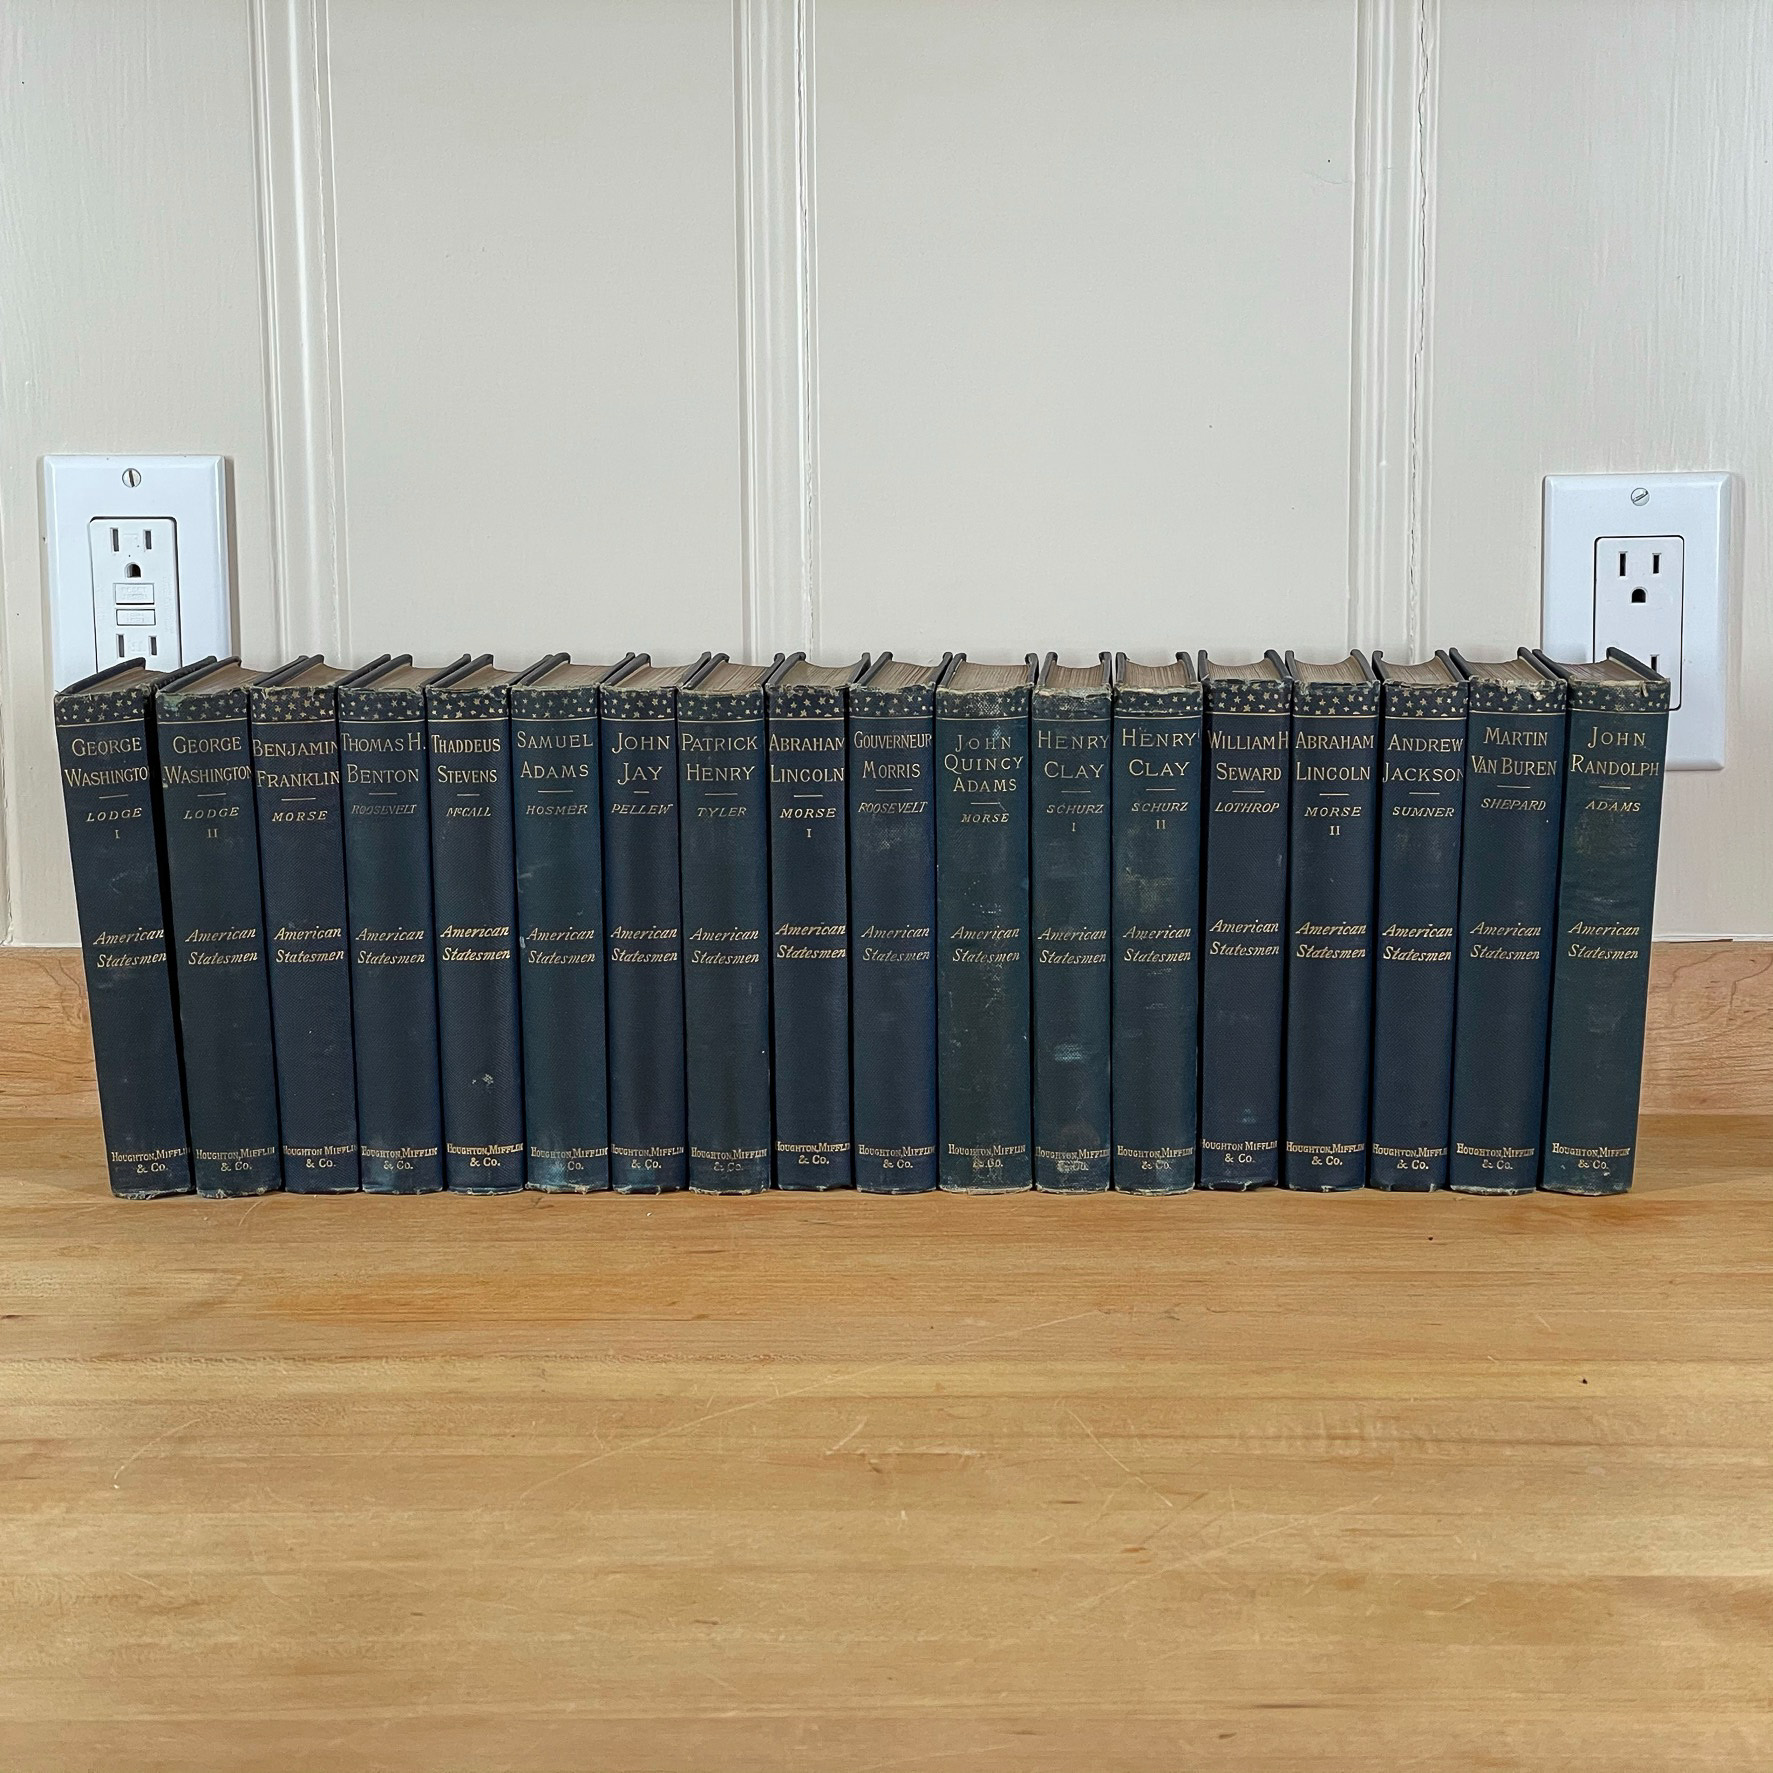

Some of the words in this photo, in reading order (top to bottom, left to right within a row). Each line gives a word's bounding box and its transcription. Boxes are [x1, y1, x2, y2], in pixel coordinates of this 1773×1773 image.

[340, 732, 404, 752] THOMAS
[408, 732, 427, 751] H.
[431, 734, 501, 753] THADDEUS
[517, 731, 594, 749] SAMUEL
[611, 732, 670, 754] JOHN
[681, 733, 758, 751] PATRICK
[853, 730, 932, 749] GOUVERNEUR
[955, 734, 1011, 752] JOHN
[1037, 730, 1110, 750] HENRY
[1121, 728, 1196, 747] HENRY
[1207, 729, 1275, 751] WILLIAM
[1295, 731, 1375, 750] ABRAHAM
[1387, 734, 1463, 752] ANDREW
[1483, 727, 1548, 746] MARTIN
[1587, 726, 1646, 749] JOHN
[71, 737, 142, 757] GEORGE
[173, 736, 242, 754] GEORGE
[520, 761, 589, 778] ADAMS
[862, 760, 921, 779] MORRIS
[944, 753, 1024, 775] QUINCY
[1044, 761, 1105, 779] CLAY
[1128, 759, 1190, 777] CLAY
[1216, 762, 1282, 781] SEWARD
[1296, 761, 1371, 781] LINCOLN
[1470, 755, 1497, 775] VAN
[1502, 757, 1557, 776] BUREN
[1570, 754, 1660, 776] RANDOLPH
[64, 766, 149, 788] WASHINGTO
[257, 770, 340, 788] FRANKLIN
[347, 764, 419, 784] BENTON
[438, 765, 498, 783] STEVENS
[617, 762, 663, 786] JAY
[686, 763, 755, 781] HENRY
[770, 764, 845, 783] LINCOLN
[953, 777, 1017, 792] ADAMS
[351, 804, 417, 815] ROOSEVELT
[526, 804, 588, 815] HOSMER
[611, 803, 674, 815] PELLEW
[858, 801, 928, 813] ROOSEVELT
[1046, 804, 1105, 814] SCHURZ
[1131, 802, 1189, 813] SCHURZ
[1215, 802, 1280, 813] LOTHROP
[1304, 806, 1362, 817] MORSE
[1392, 806, 1455, 817] SUMNER
[1480, 798, 1546, 811] SHEPARD
[1585, 801, 1641, 812] ADAMS
[87, 808, 142, 822] LODGE
[183, 807, 240, 820] LODGE
[272, 810, 328, 822] MORSE
[697, 807, 747, 818] TYLER
[779, 807, 837, 819] MORSE
[961, 813, 1010, 823] MORSE
[1071, 822, 1076, 832] I
[1155, 819, 1166, 829] II
[1329, 825, 1340, 836] II
[115, 829, 120, 839] I
[207, 829, 218, 838] II
[806, 828, 812, 838] I
[274, 925, 342, 941] American
[355, 926, 425, 941] American
[439, 924, 510, 938] American
[526, 926, 595, 941] American
[610, 925, 678, 939] American
[689, 926, 759, 941] American
[775, 922, 846, 936] American
[860, 924, 930, 938] American
[950, 925, 1020, 940] American
[1037, 926, 1107, 941] American
[1122, 924, 1192, 939] American
[1209, 919, 1279, 933] American
[1295, 921, 1367, 936] American
[1382, 923, 1454, 938] American
[1470, 921, 1541, 937] American
[1567, 921, 1640, 937] American
[93, 927, 165, 946] American
[185, 925, 256, 943] American
[275, 949, 345, 963] Statesmen
[442, 947, 511, 961] Statesmen
[611, 948, 678, 963] Statesmen
[776, 944, 846, 959] Statesmen
[862, 947, 930, 962] Statesmen
[952, 948, 1020, 963] Statesmen
[1123, 948, 1191, 963] Statesmen
[1209, 941, 1280, 956] Statesmen
[1296, 944, 1366, 959] Statesmen
[1382, 946, 1452, 961] Statesmen
[1470, 944, 1540, 960] Statesmen
[1567, 943, 1639, 960] Statesmen
[97, 952, 167, 968] Statesmen
[188, 951, 258, 966] Statesmen
[357, 950, 425, 965] Statesmen
[528, 950, 596, 964] Statesmen
[691, 950, 760, 964] Statesmen
[1039, 950, 1107, 964] Statesmen
